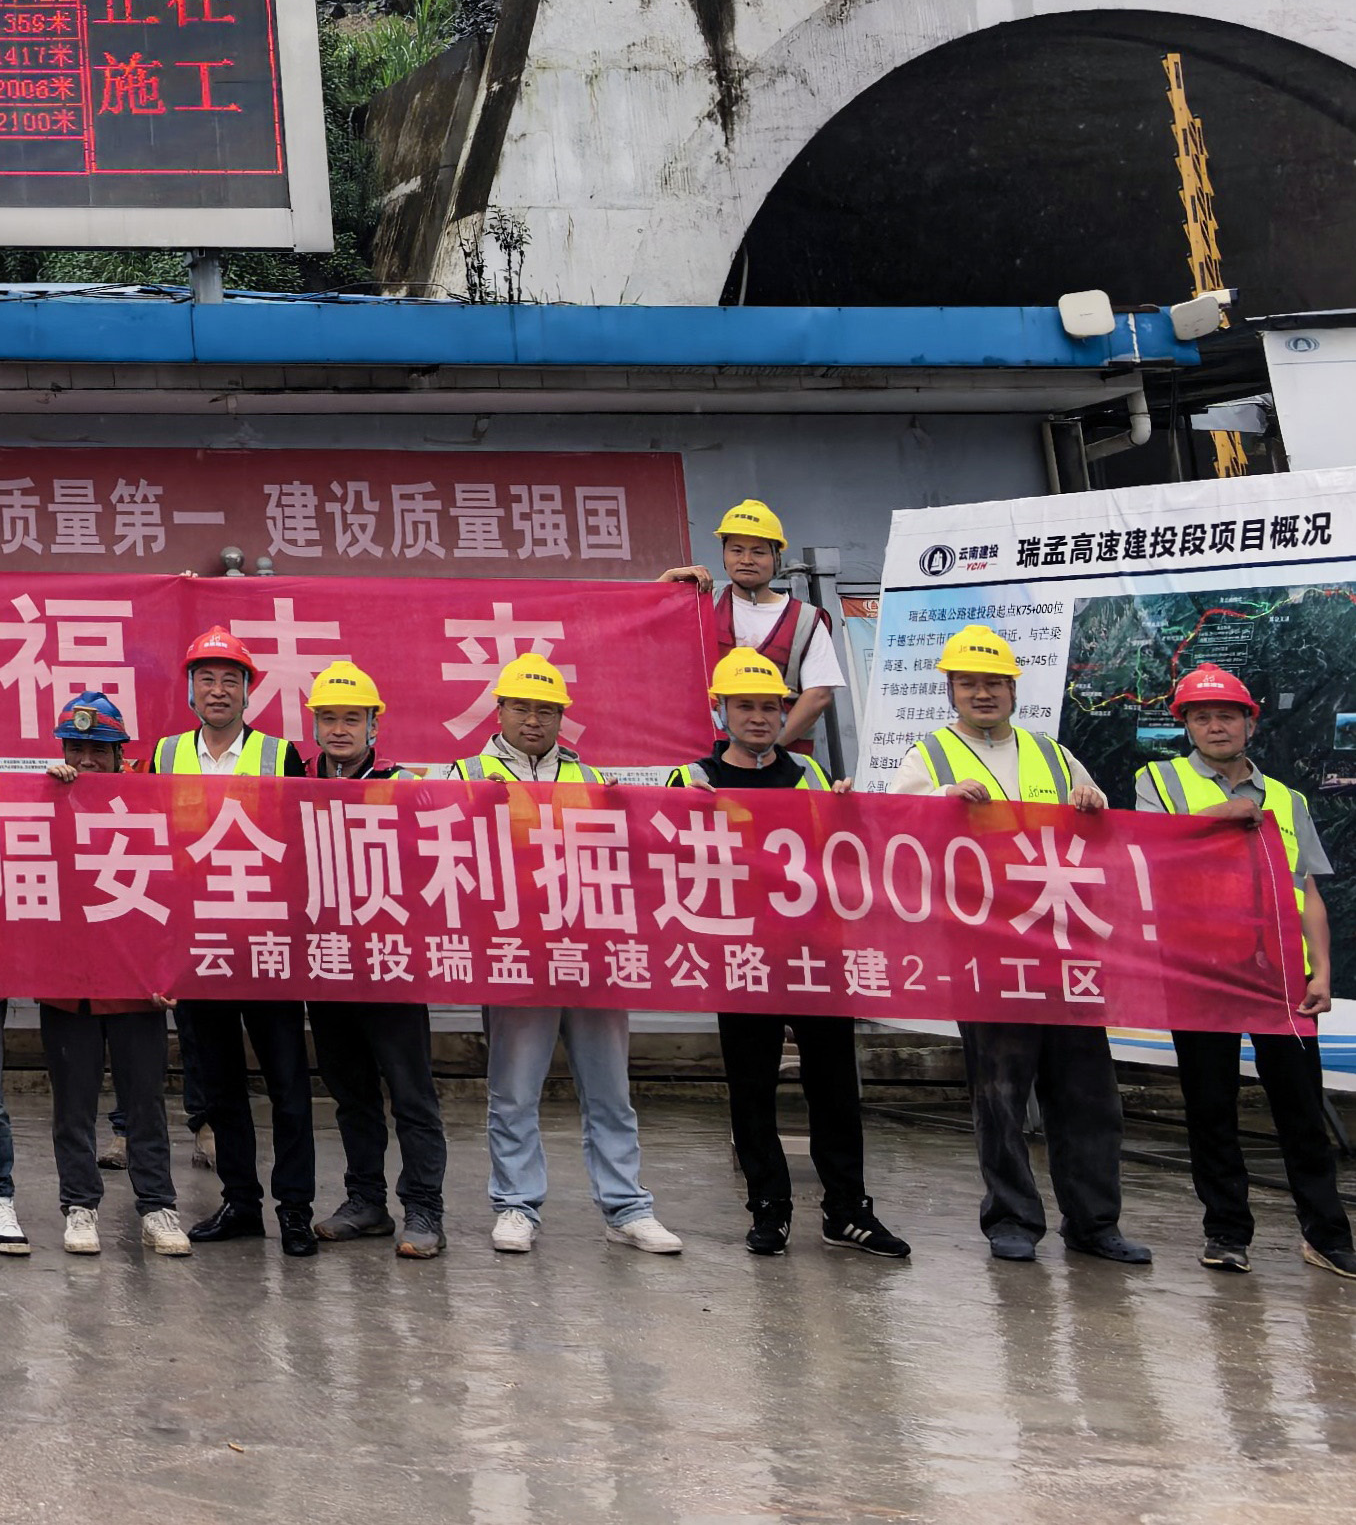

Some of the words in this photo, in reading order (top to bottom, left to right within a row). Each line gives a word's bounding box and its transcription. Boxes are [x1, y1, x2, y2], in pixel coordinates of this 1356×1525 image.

[98, 51, 242, 116] 施工
[263, 480, 632, 561] 建设质量强国
[959, 543, 999, 561] 云南建投
[1016, 511, 1333, 568] 瑞孟高速建投段项目概况
[190, 931, 1106, 1004] 云南建投瑞孟高速公路土建2-1工区
